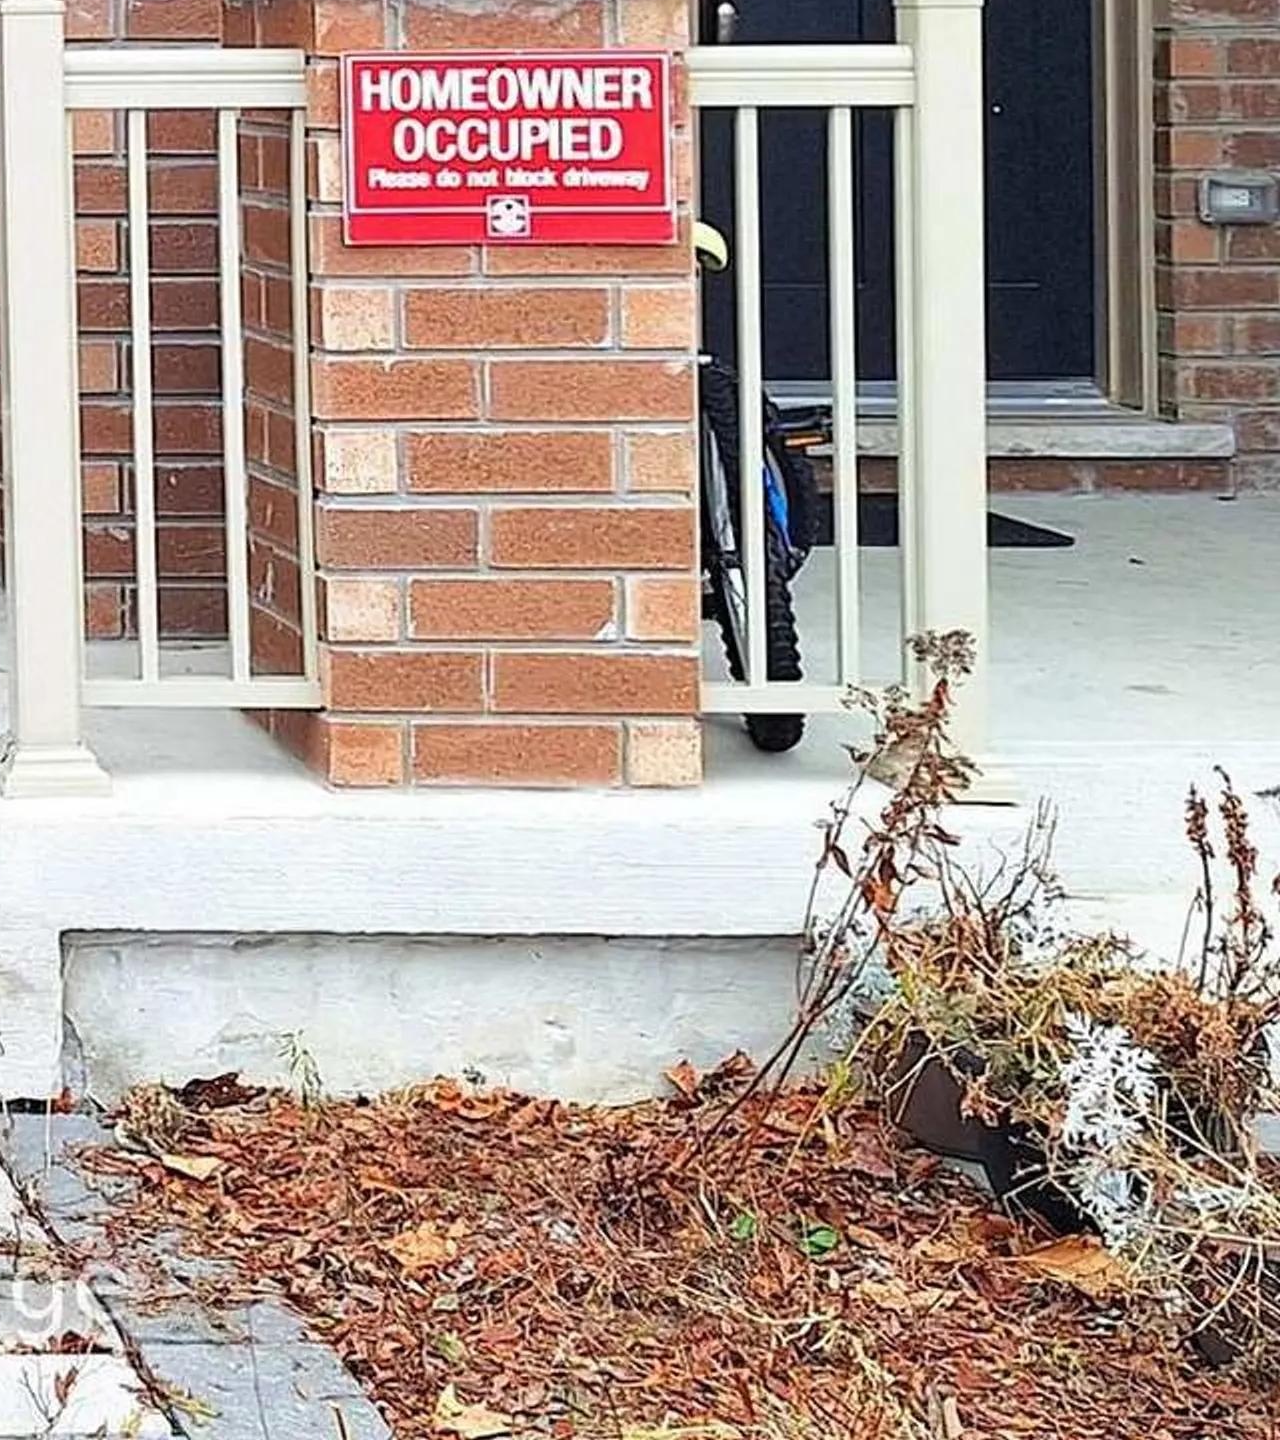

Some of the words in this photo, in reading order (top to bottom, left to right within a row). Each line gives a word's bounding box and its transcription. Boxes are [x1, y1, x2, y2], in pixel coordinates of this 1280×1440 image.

[359, 66, 653, 112] HOMEOWNER
[392, 117, 623, 161] OCCUPIED
[367, 168, 431, 189] Please
[436, 168, 463, 188] do
[467, 168, 500, 188] not
[504, 167, 558, 188] block
[562, 167, 650, 192] driveway
